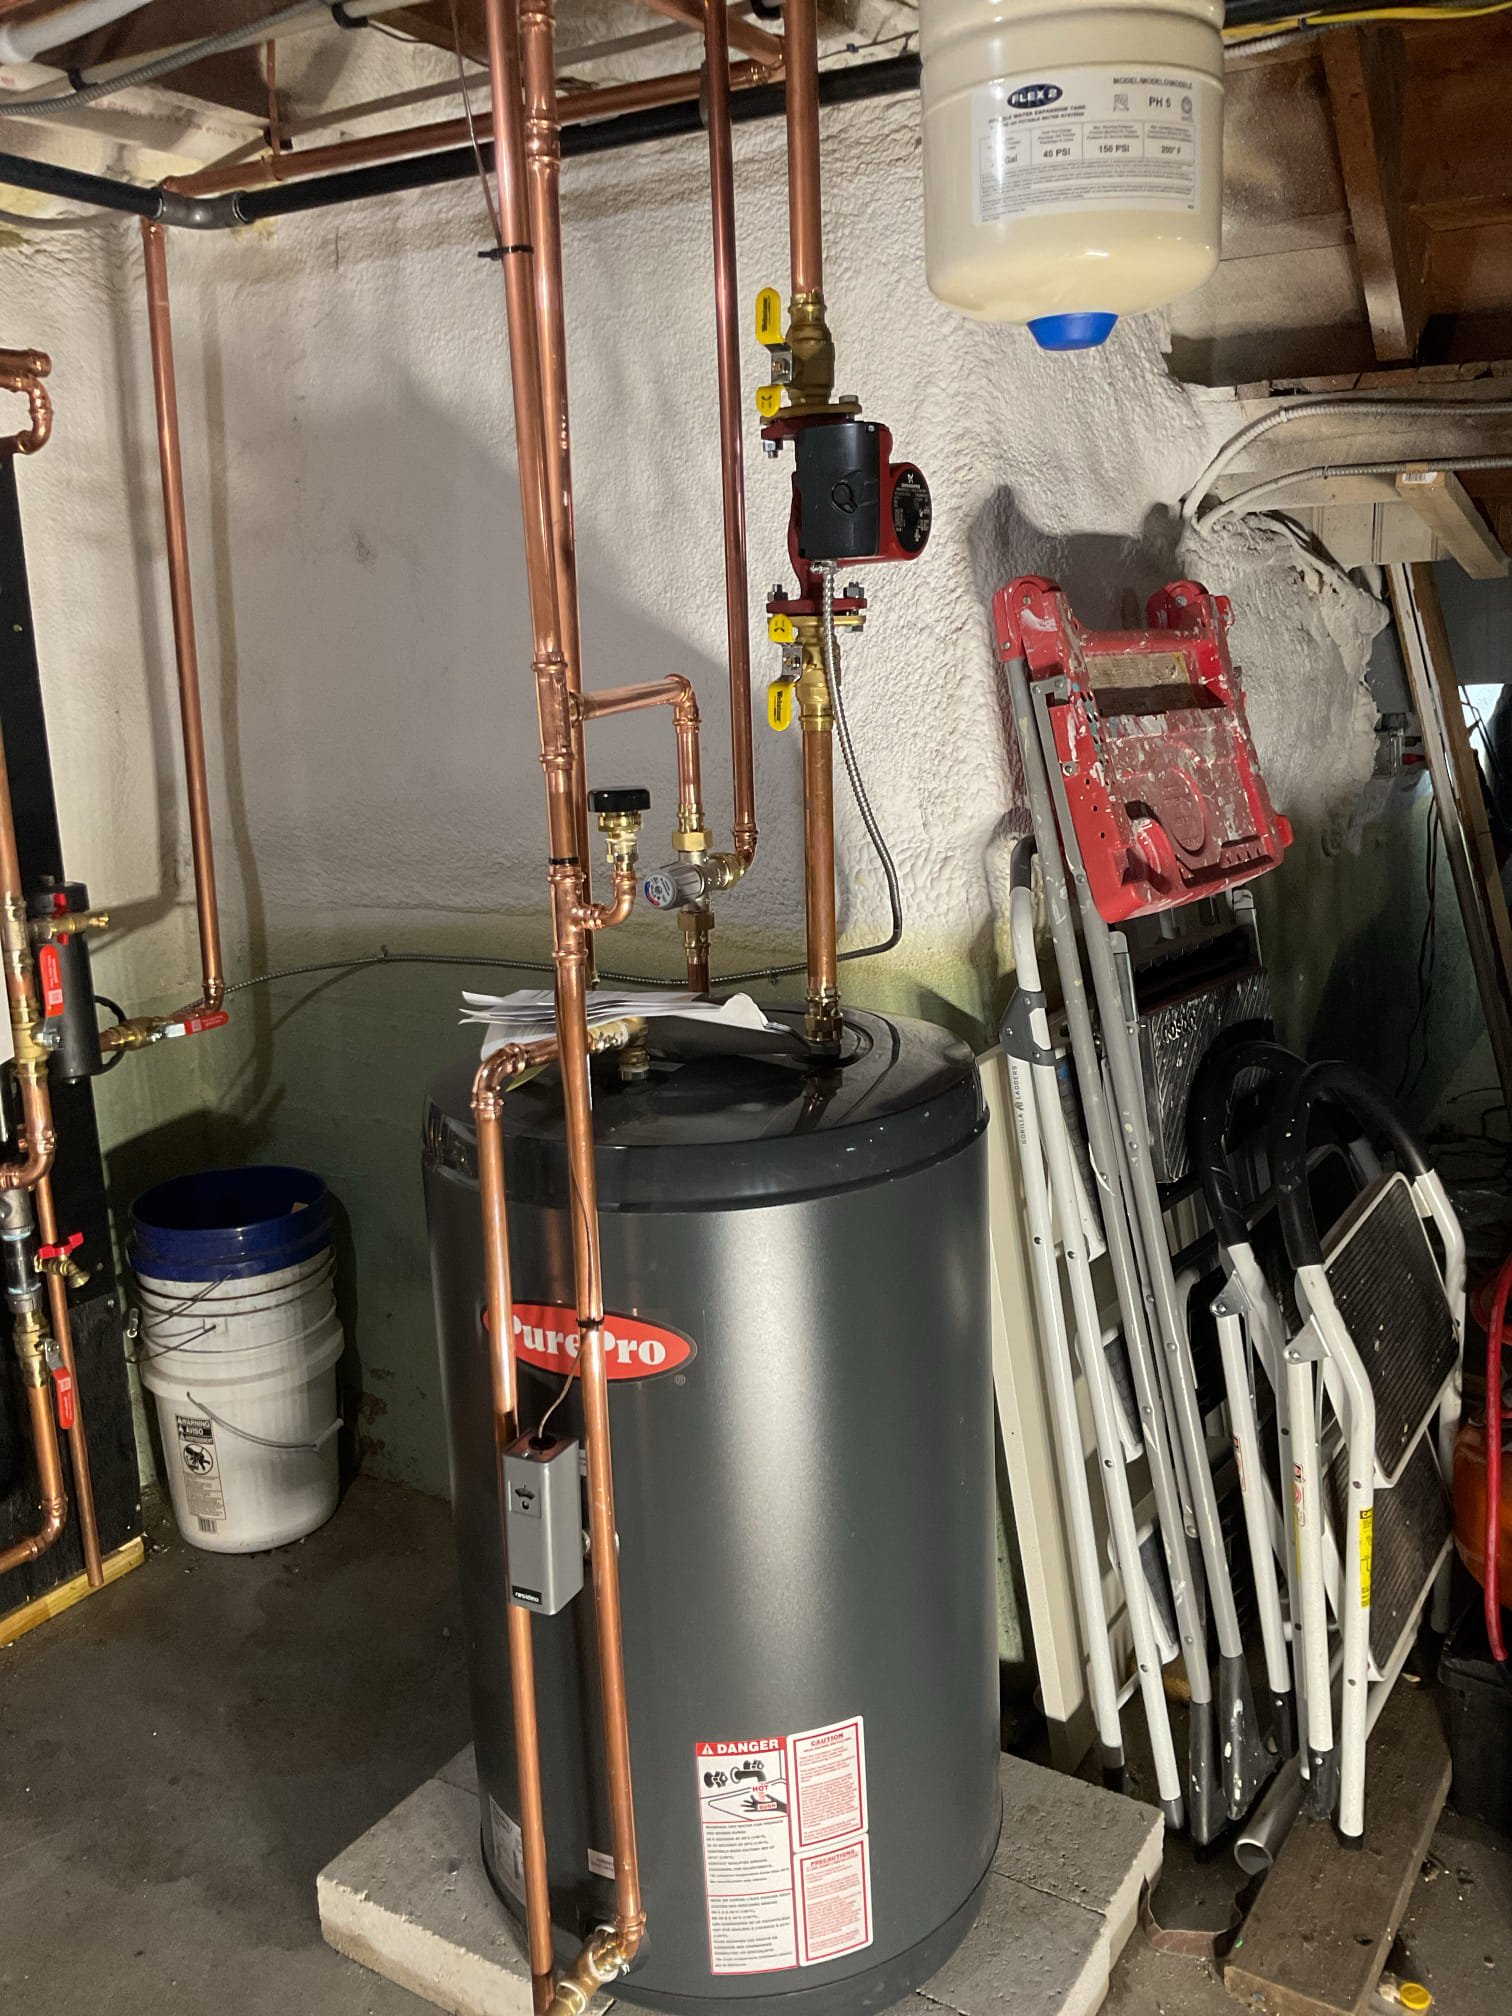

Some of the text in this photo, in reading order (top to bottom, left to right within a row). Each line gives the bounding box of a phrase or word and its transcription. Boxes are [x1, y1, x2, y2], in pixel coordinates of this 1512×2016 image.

[1011, 90, 1045, 105] FLEX
[1148, 96, 1163, 108] PH
[1043, 147, 1071, 159] 40 PSI
[1098, 144, 1130, 154] 150 PSI
[1012, 1065, 1028, 1145] GORILLA LADDERS
[810, 1732, 844, 1747] CAUTION
[716, 1739, 779, 1754] DANGER
[752, 1784, 769, 1793] HOT
